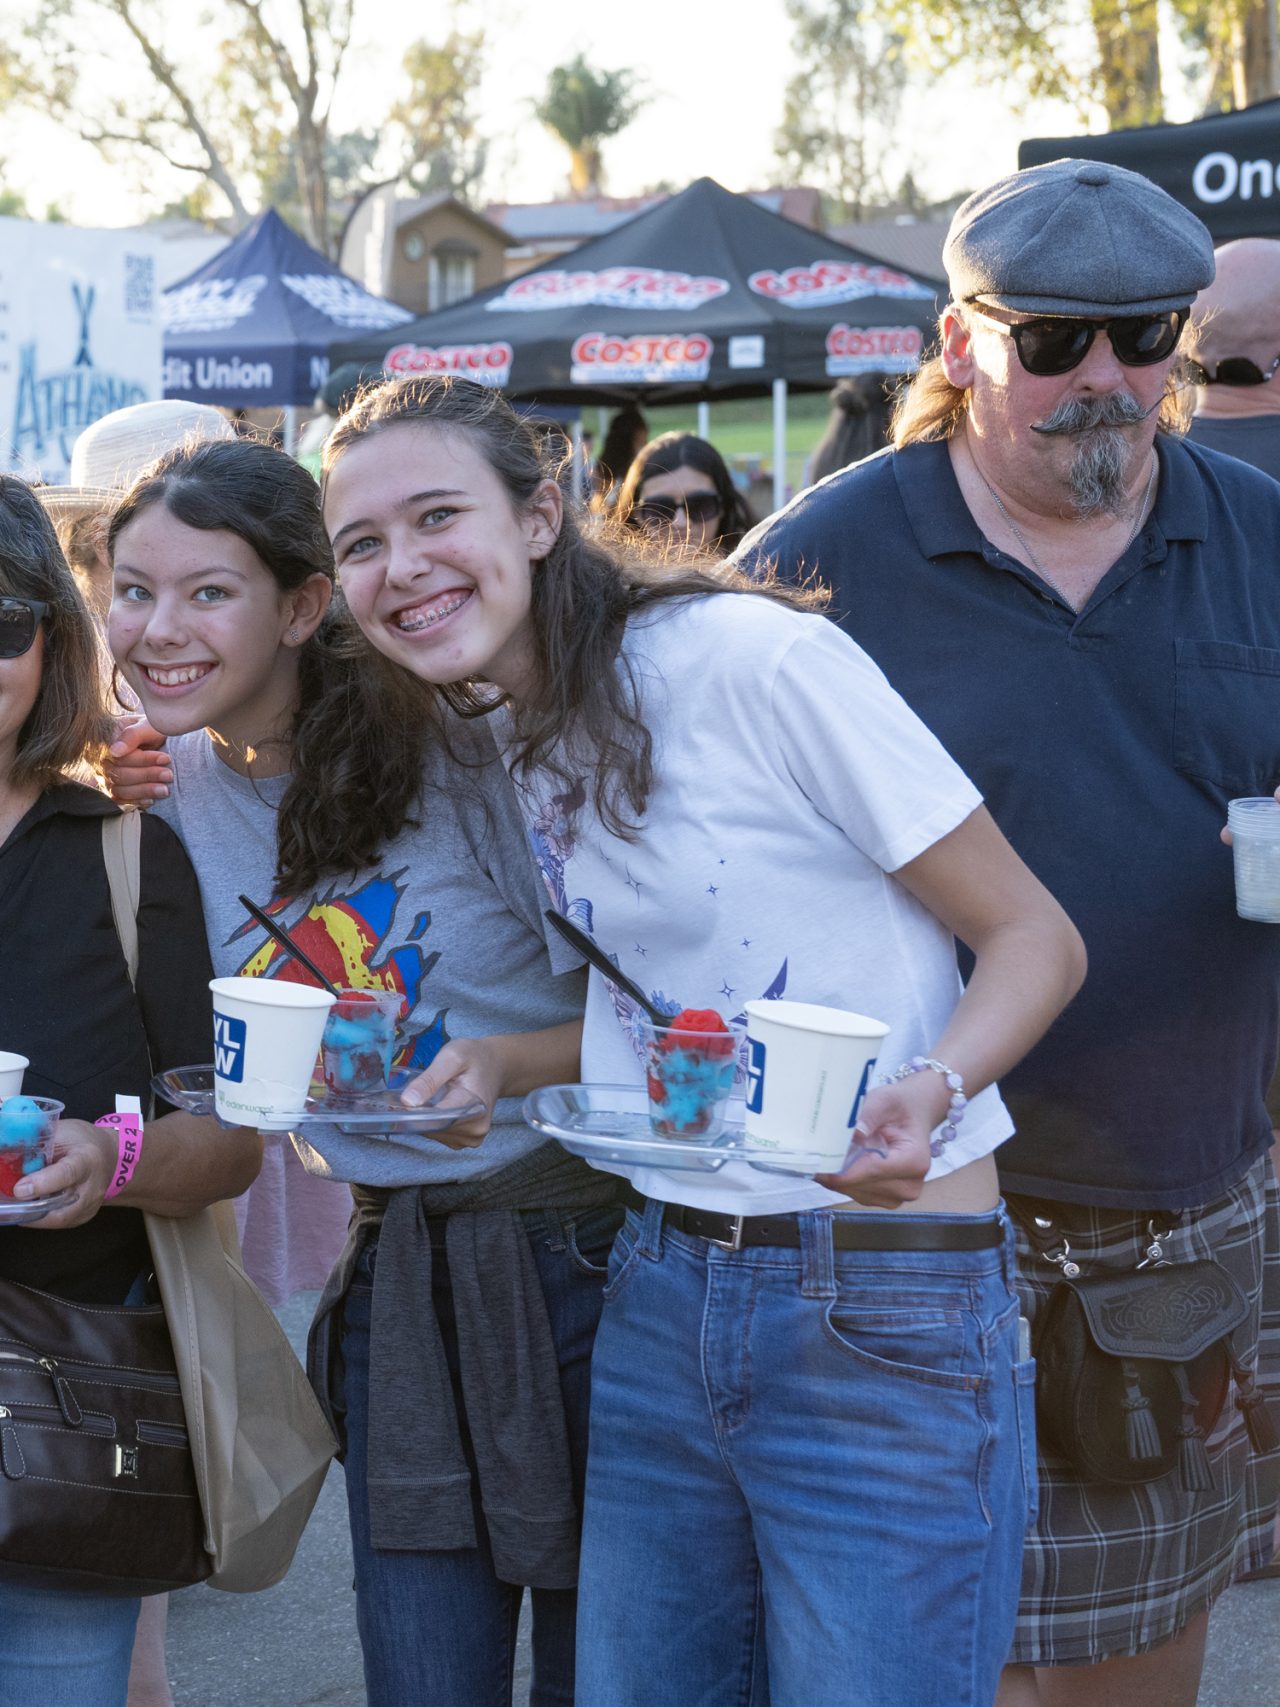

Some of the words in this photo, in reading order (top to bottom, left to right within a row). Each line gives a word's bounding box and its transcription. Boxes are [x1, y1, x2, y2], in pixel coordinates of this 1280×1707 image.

[1192, 152, 1280, 204] On
[575, 334, 710, 364] COSTCO
[829, 327, 922, 357] COSTCO
[195, 356, 273, 389] Union
[116, 1141, 137, 1187] OVER
